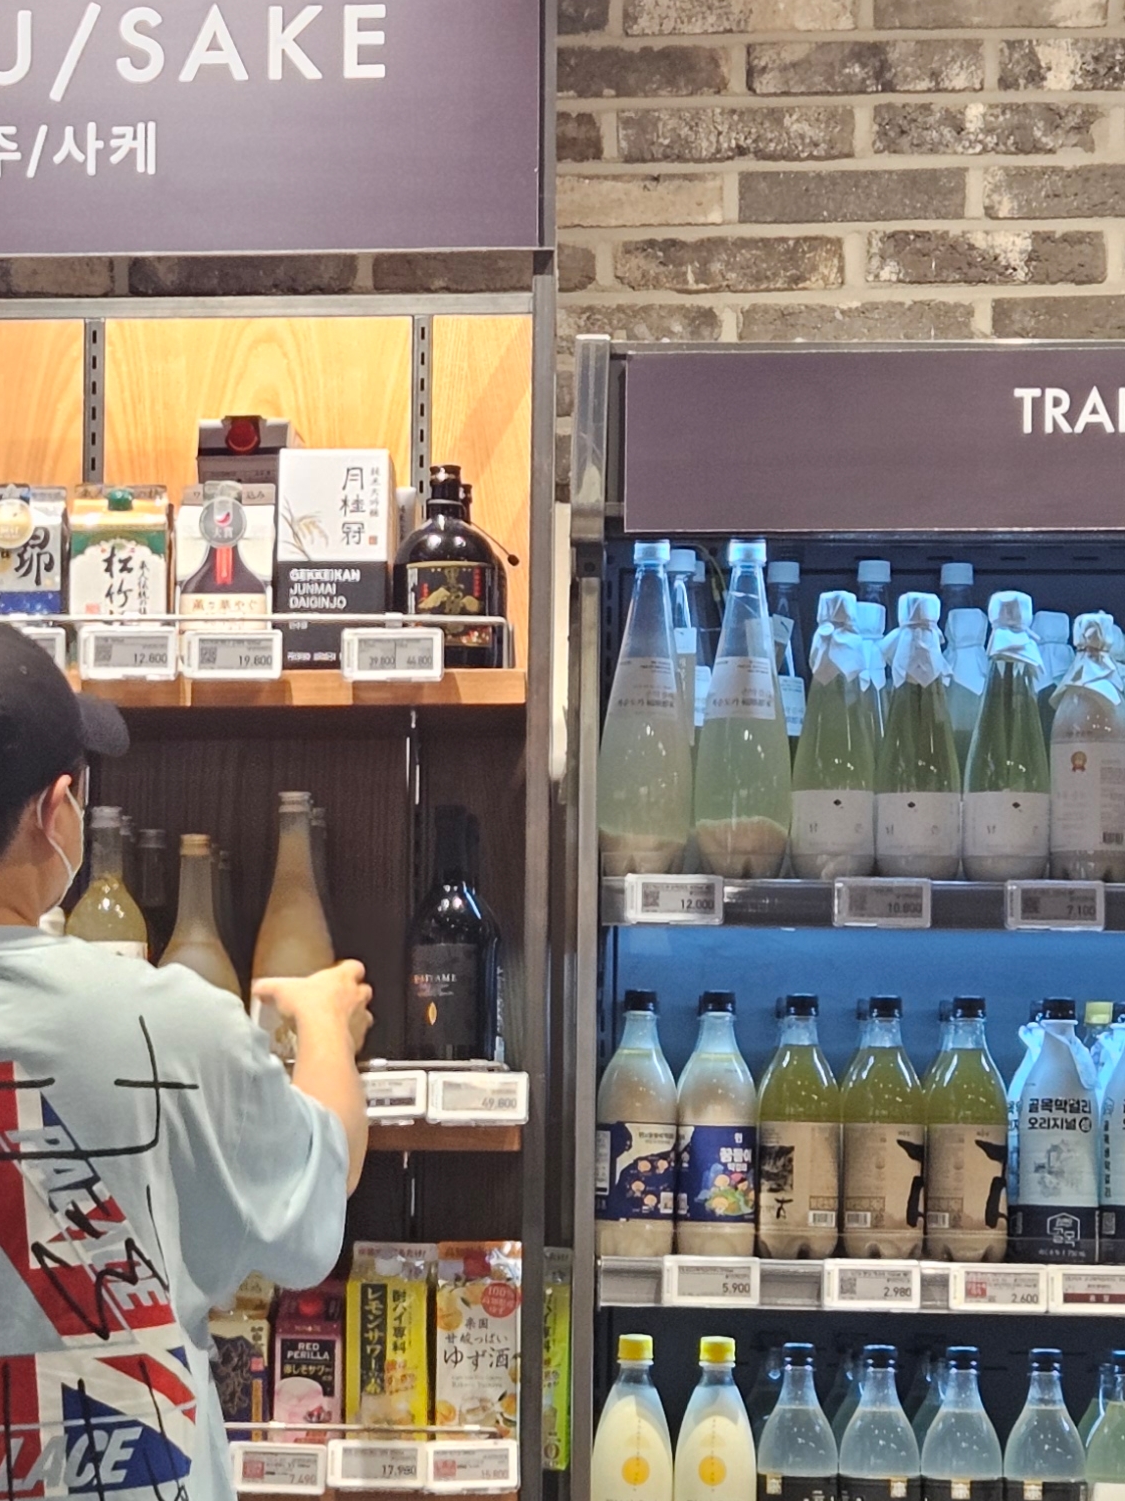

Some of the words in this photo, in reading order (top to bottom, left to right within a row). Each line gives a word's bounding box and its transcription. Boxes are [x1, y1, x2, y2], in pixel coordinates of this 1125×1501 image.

[1014, 386, 1125, 434] TRA
[339, 466, 367, 546] 月桂冠
[103, 545, 132, 615] 松竹
[289, 569, 361, 582] GEKKEIKAN
[289, 583, 337, 595] JUNMAI
[289, 597, 347, 609] DAIGINJO
[133, 652, 167, 664] 12.800
[238, 654, 272, 667] 19.800
[681, 898, 714, 910] 12.000
[1027, 1097, 1092, 1114] 골목막걸리
[1027, 1116, 1077, 1131] 오리지널
[722, 1283, 750, 1294] 5.900
[884, 1287, 911, 1298] 2.980
[1012, 1293, 1038, 1304] 2.600
[445, 1333, 509, 1346] 甘酸っぱい
[297, 1342, 320, 1351] RED
[287, 1351, 330, 1360] PERILLA
[443, 1347, 511, 1371] ゆず酒
[289, 1473, 316, 1483] 7.490
